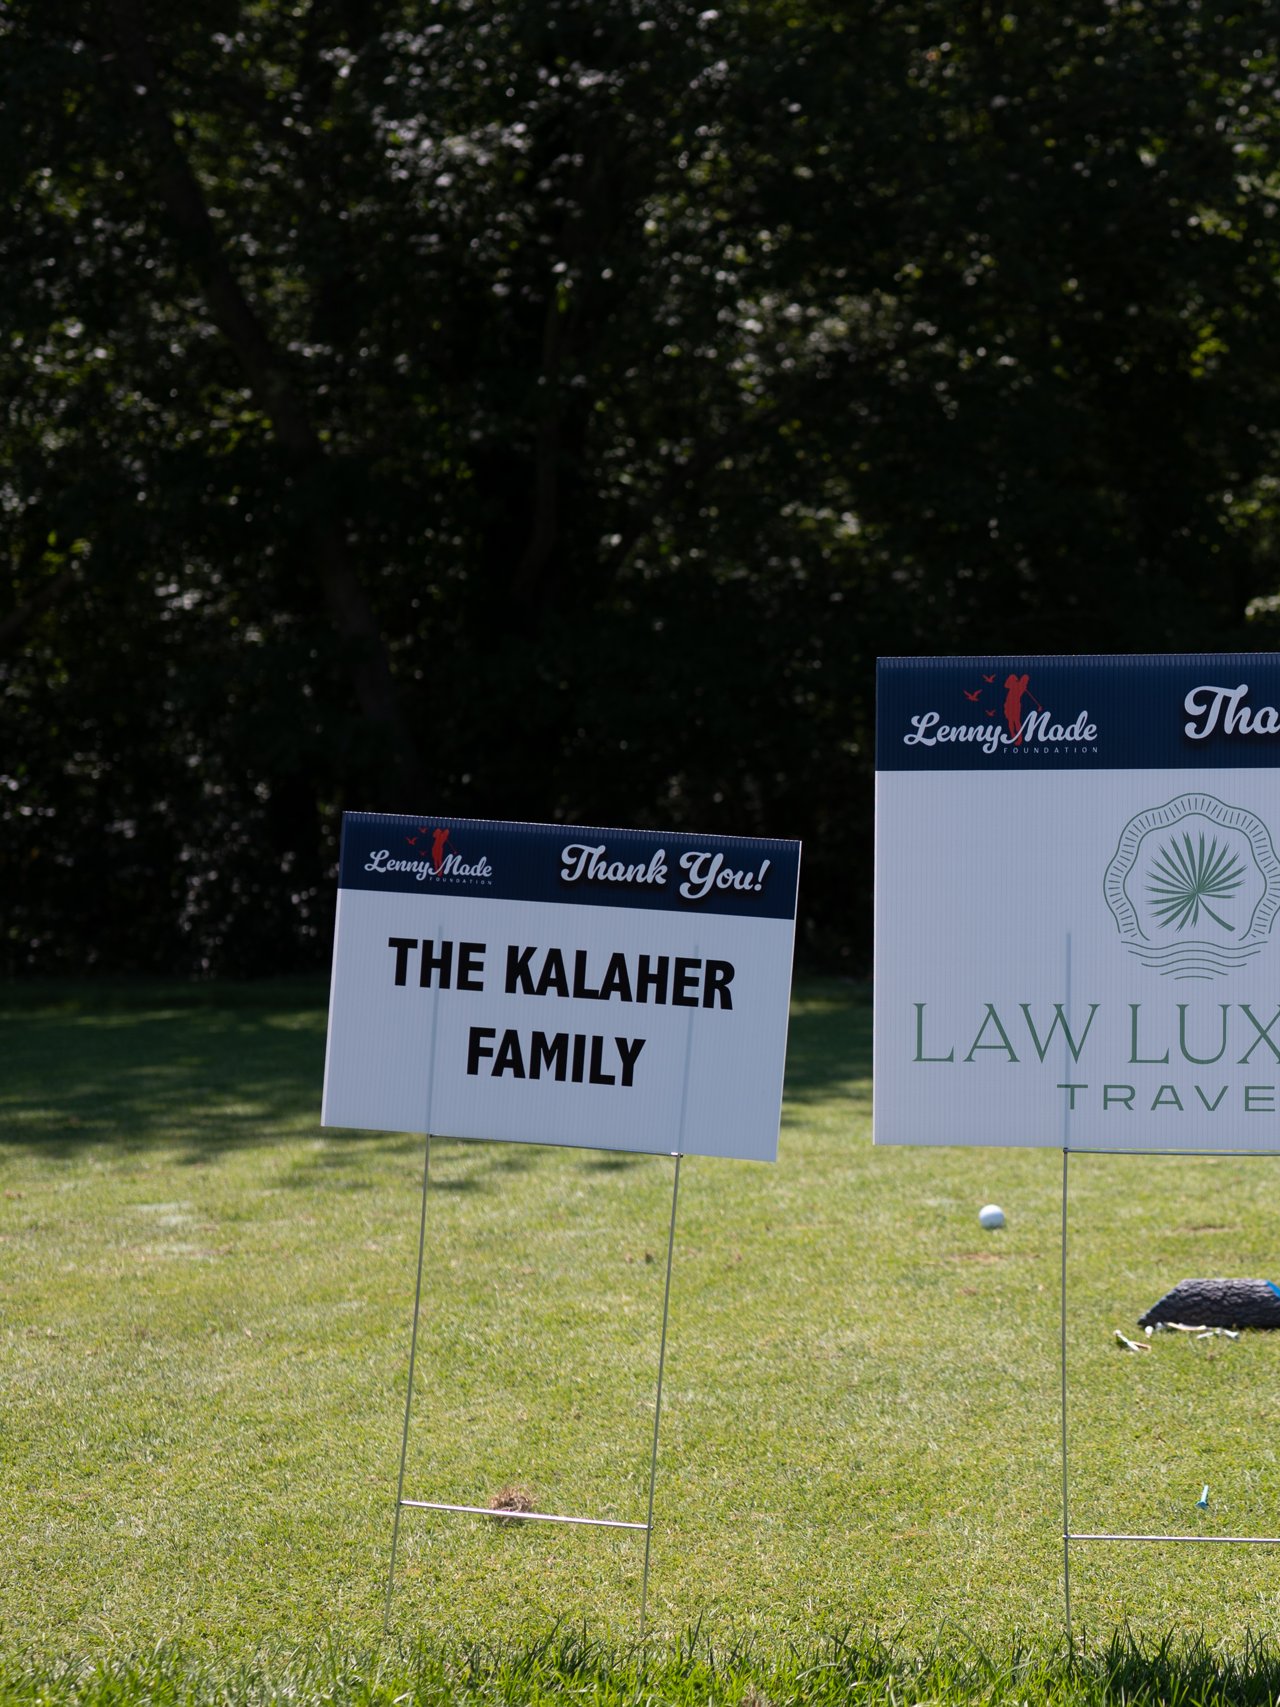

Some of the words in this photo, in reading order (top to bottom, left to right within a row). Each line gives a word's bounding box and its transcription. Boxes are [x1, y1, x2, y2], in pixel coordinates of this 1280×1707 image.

[903, 711, 1004, 754] Lenny
[1002, 710, 1098, 745] Made
[364, 849, 430, 881] Lenny
[429, 853, 493, 877] Made
[429, 877, 493, 886] FOUNDATION
[560, 843, 667, 885] Thank
[679, 851, 771, 899] You!
[388, 937, 487, 991] THE
[505, 945, 736, 1010] KALAHER
[467, 1026, 647, 1087] FAMILY
[912, 1003, 1101, 1064] LAW
